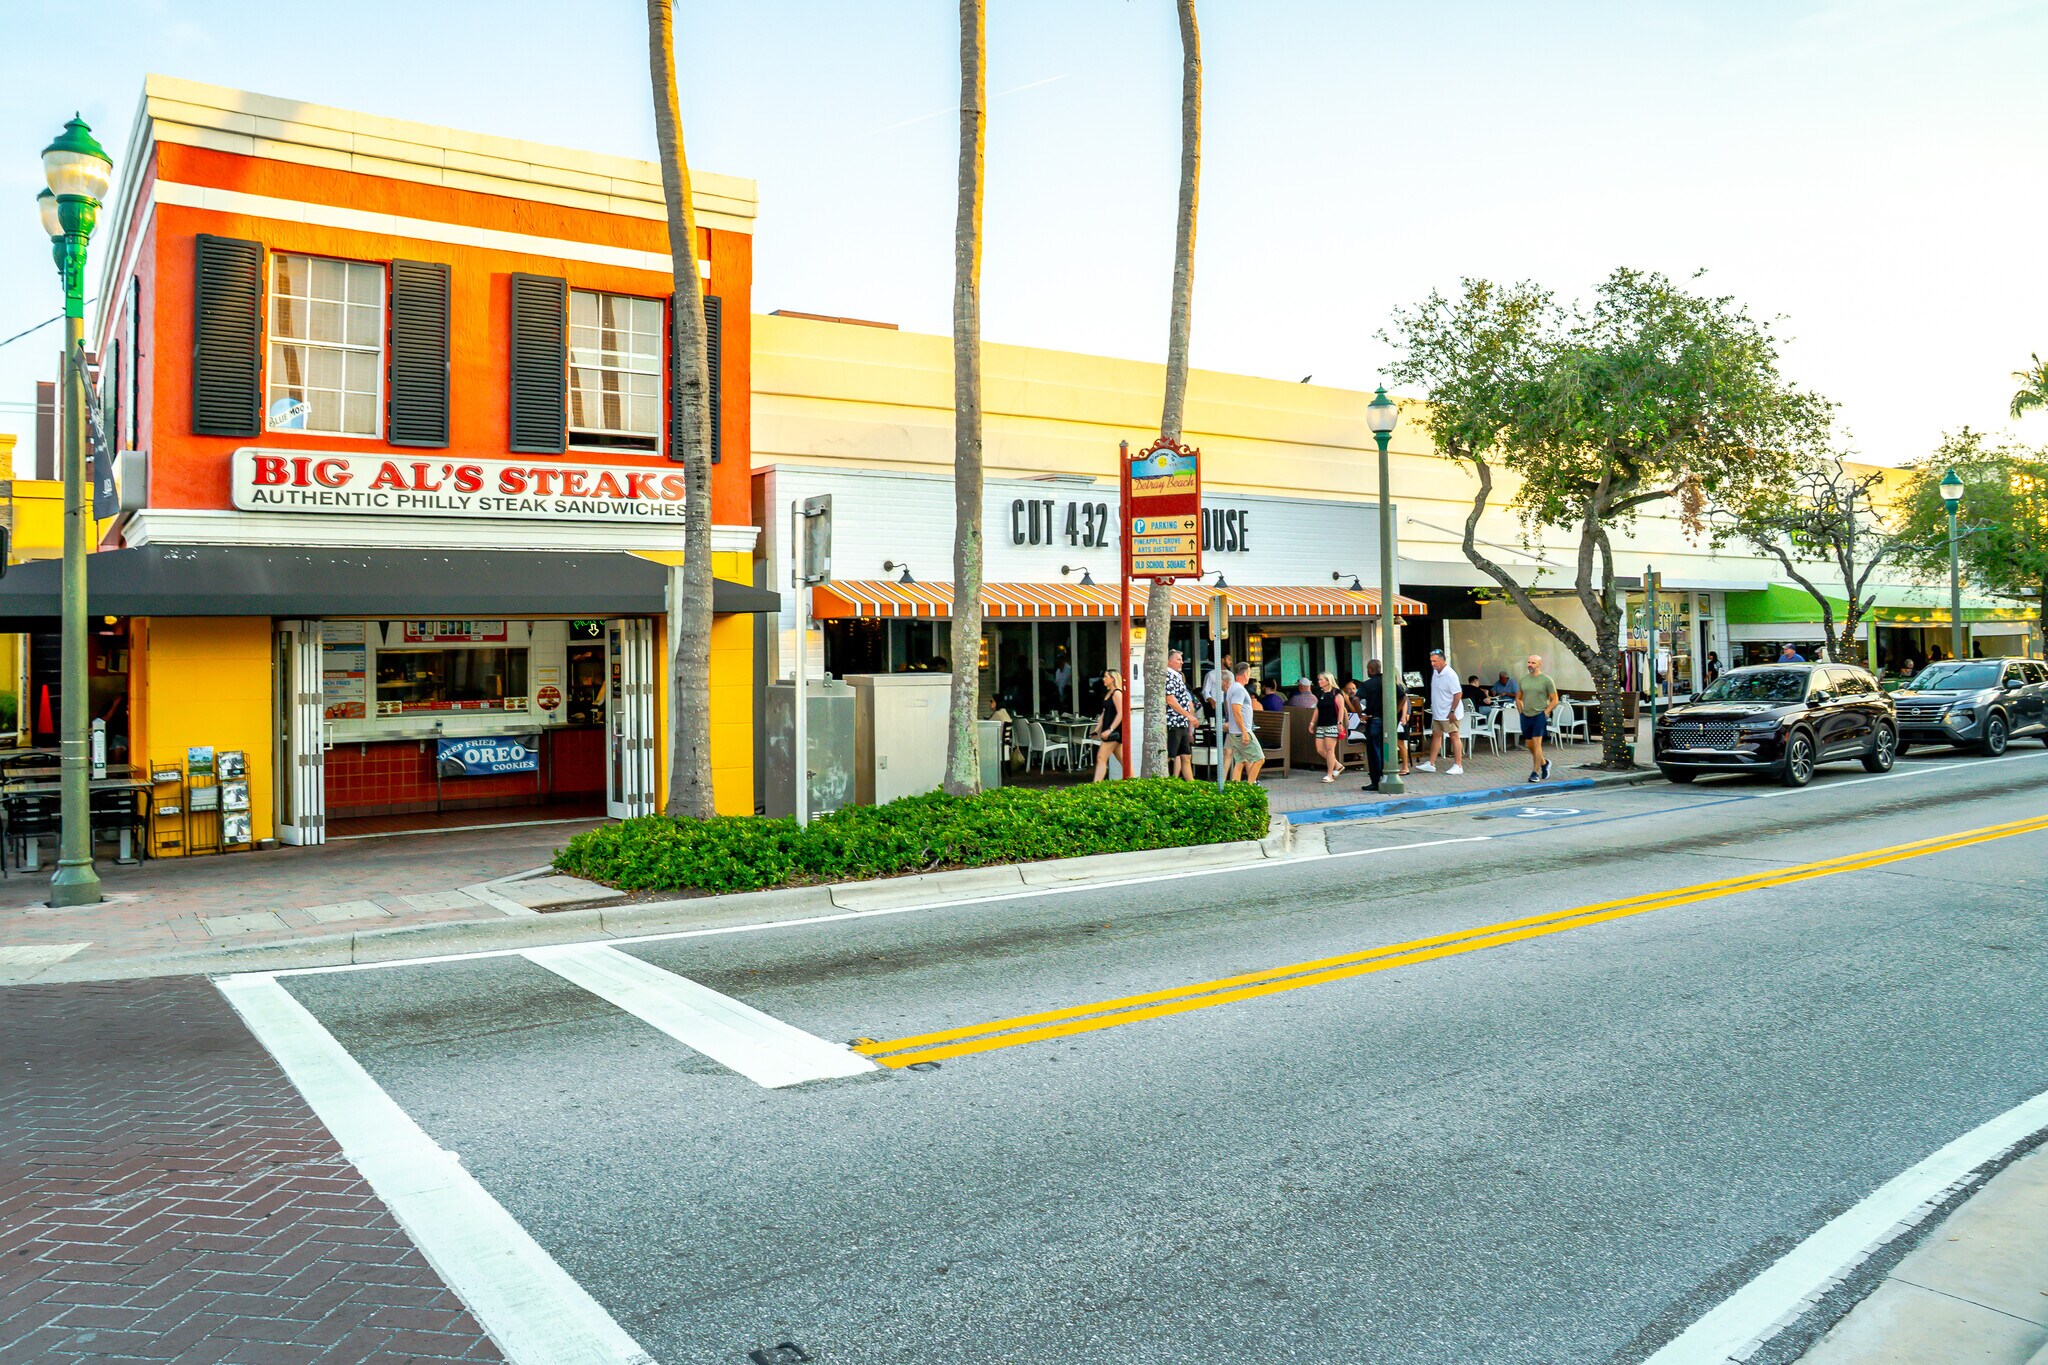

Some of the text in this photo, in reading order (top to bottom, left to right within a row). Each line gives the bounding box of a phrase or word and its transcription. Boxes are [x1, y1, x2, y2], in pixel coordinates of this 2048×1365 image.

[251, 455, 686, 500] BIG AL'S STEAKS
[1133, 474, 1194, 493] Delray Beach
[251, 489, 686, 517] AUTHENTIC PHILLY STEAK SANDWICHES
[1012, 499, 1249, 552] CUT 432 OUSE
[1151, 521, 1178, 530] PARKING
[1163, 537, 1181, 545] GROVE
[1135, 560, 1186, 569] OLD SCHOOL SQUARE
[440, 739, 496, 760] DEEP FRIED
[464, 745, 525, 764] OREO
[492, 761, 535, 771] COOKIES
